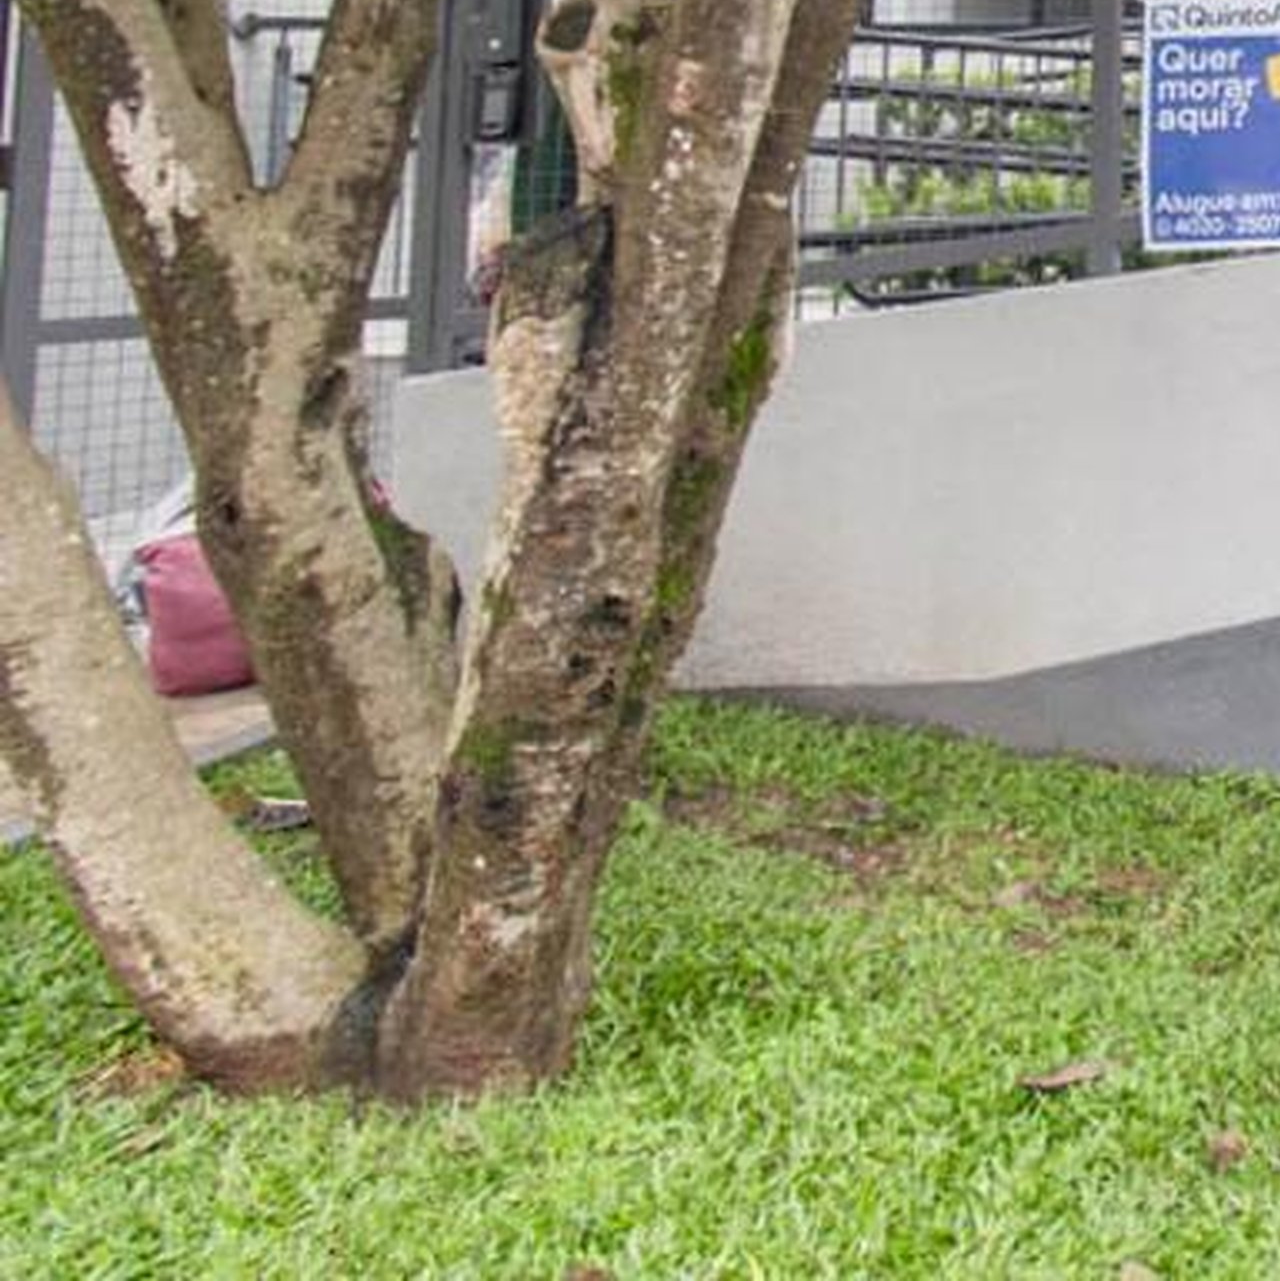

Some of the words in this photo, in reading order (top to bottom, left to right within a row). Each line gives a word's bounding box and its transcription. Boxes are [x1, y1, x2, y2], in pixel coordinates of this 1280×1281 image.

[1158, 44, 1243, 73] Quer
[1157, 76, 1259, 103] morar
[1157, 103, 1250, 134] aqui?
[1155, 191, 1236, 217] Alugue
